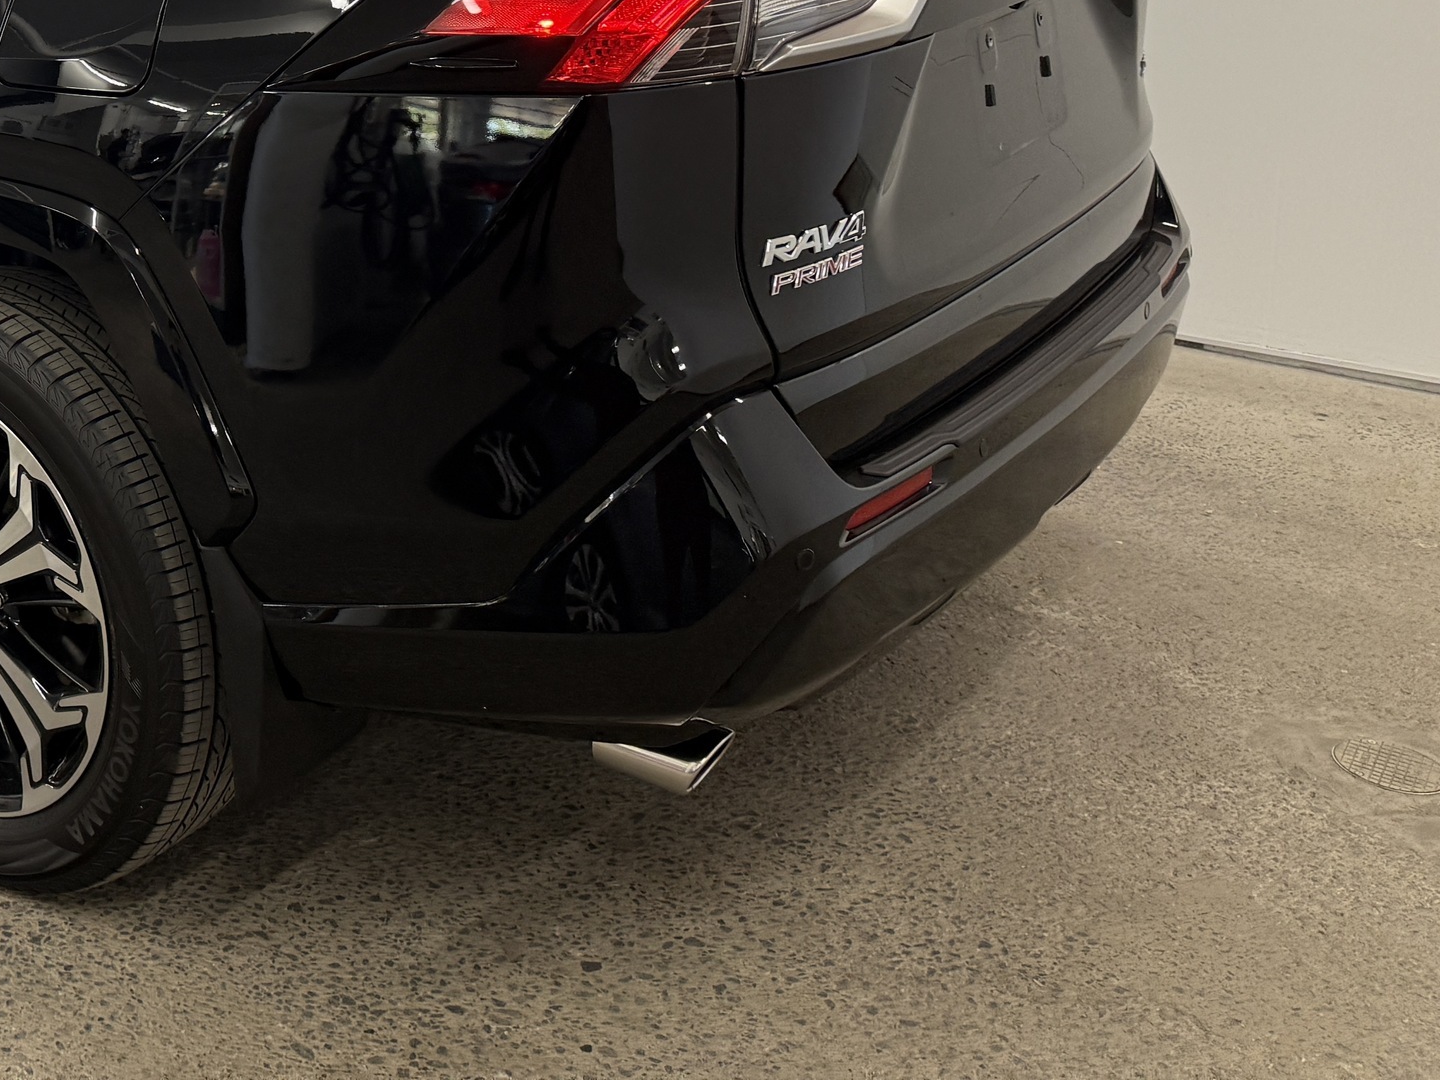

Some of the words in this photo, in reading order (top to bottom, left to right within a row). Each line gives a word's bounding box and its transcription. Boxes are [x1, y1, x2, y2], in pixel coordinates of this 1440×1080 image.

[762, 210, 867, 268] RAV4
[770, 244, 865, 297] PRIME
[65, 704, 141, 846] YOKOHAMA
